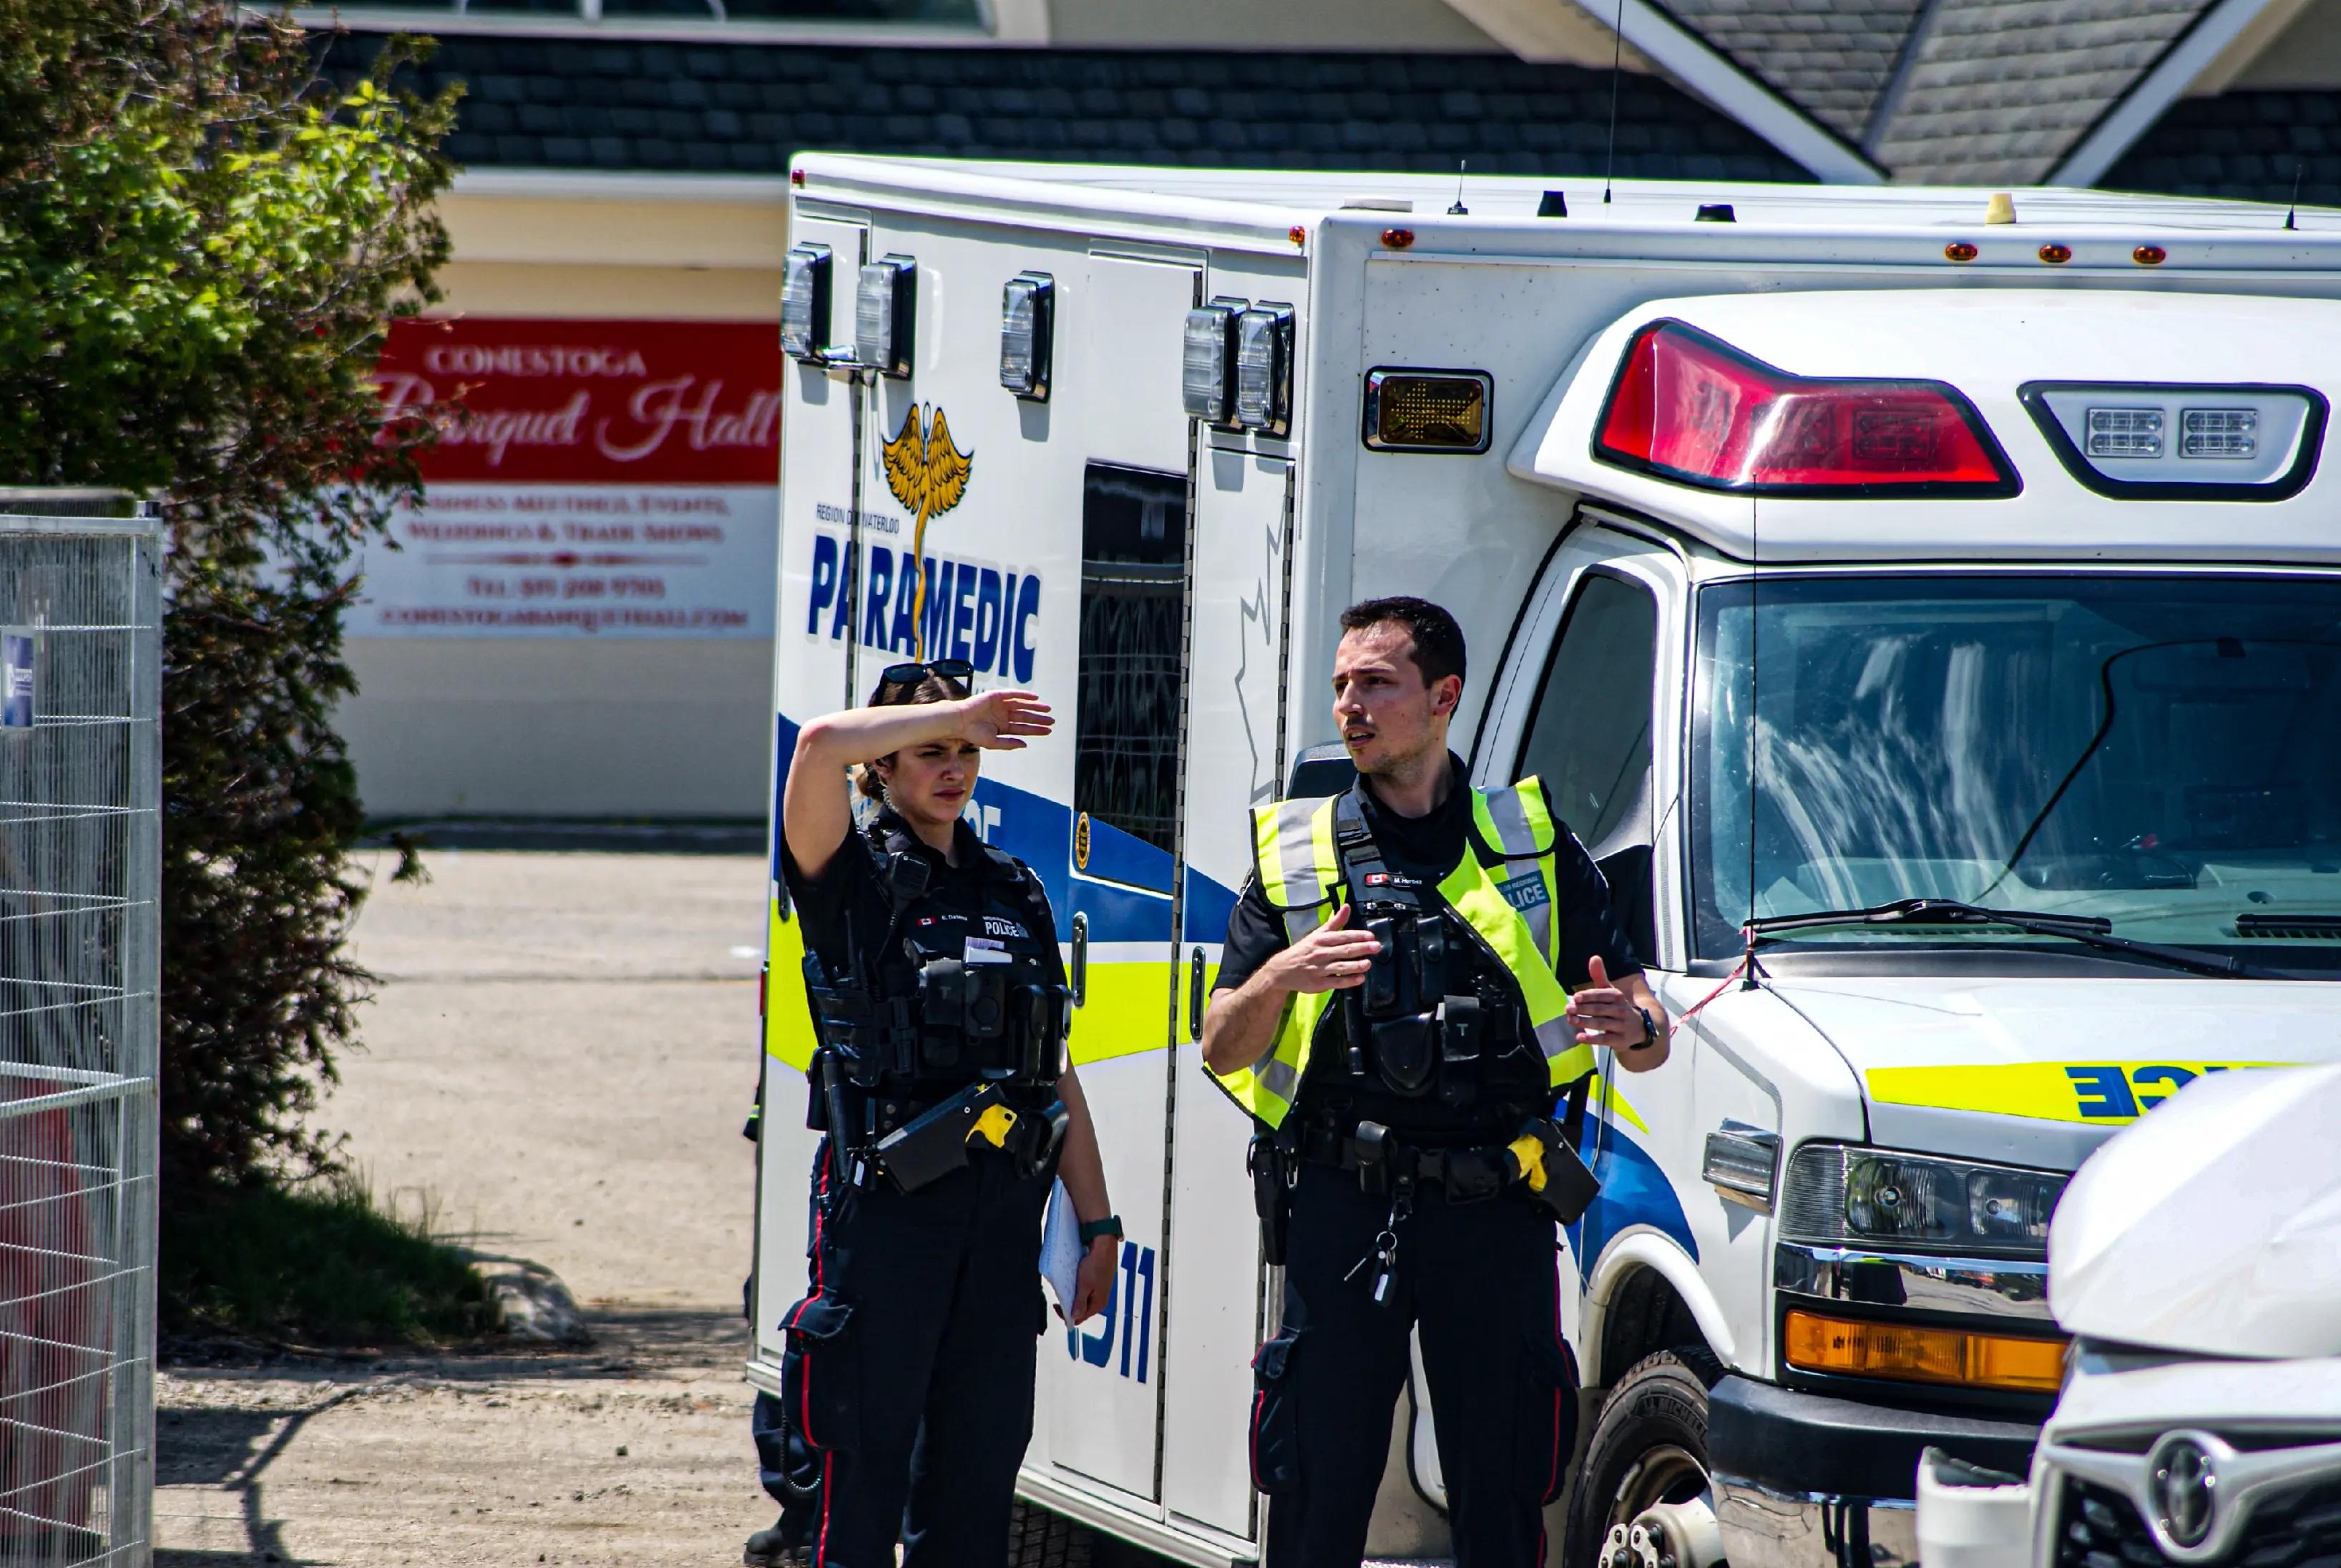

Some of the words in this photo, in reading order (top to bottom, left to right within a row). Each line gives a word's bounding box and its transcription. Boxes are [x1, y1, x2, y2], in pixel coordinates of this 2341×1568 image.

[427, 346, 647, 376] CONESTOGA
[595, 373, 780, 461] Hall
[816, 504, 844, 523] REGION
[861, 513, 899, 534] WATERLOO
[808, 535, 1041, 684] PARAMEDIC
[1507, 883, 1546, 908] LICE
[985, 921, 1020, 937] POLICE
